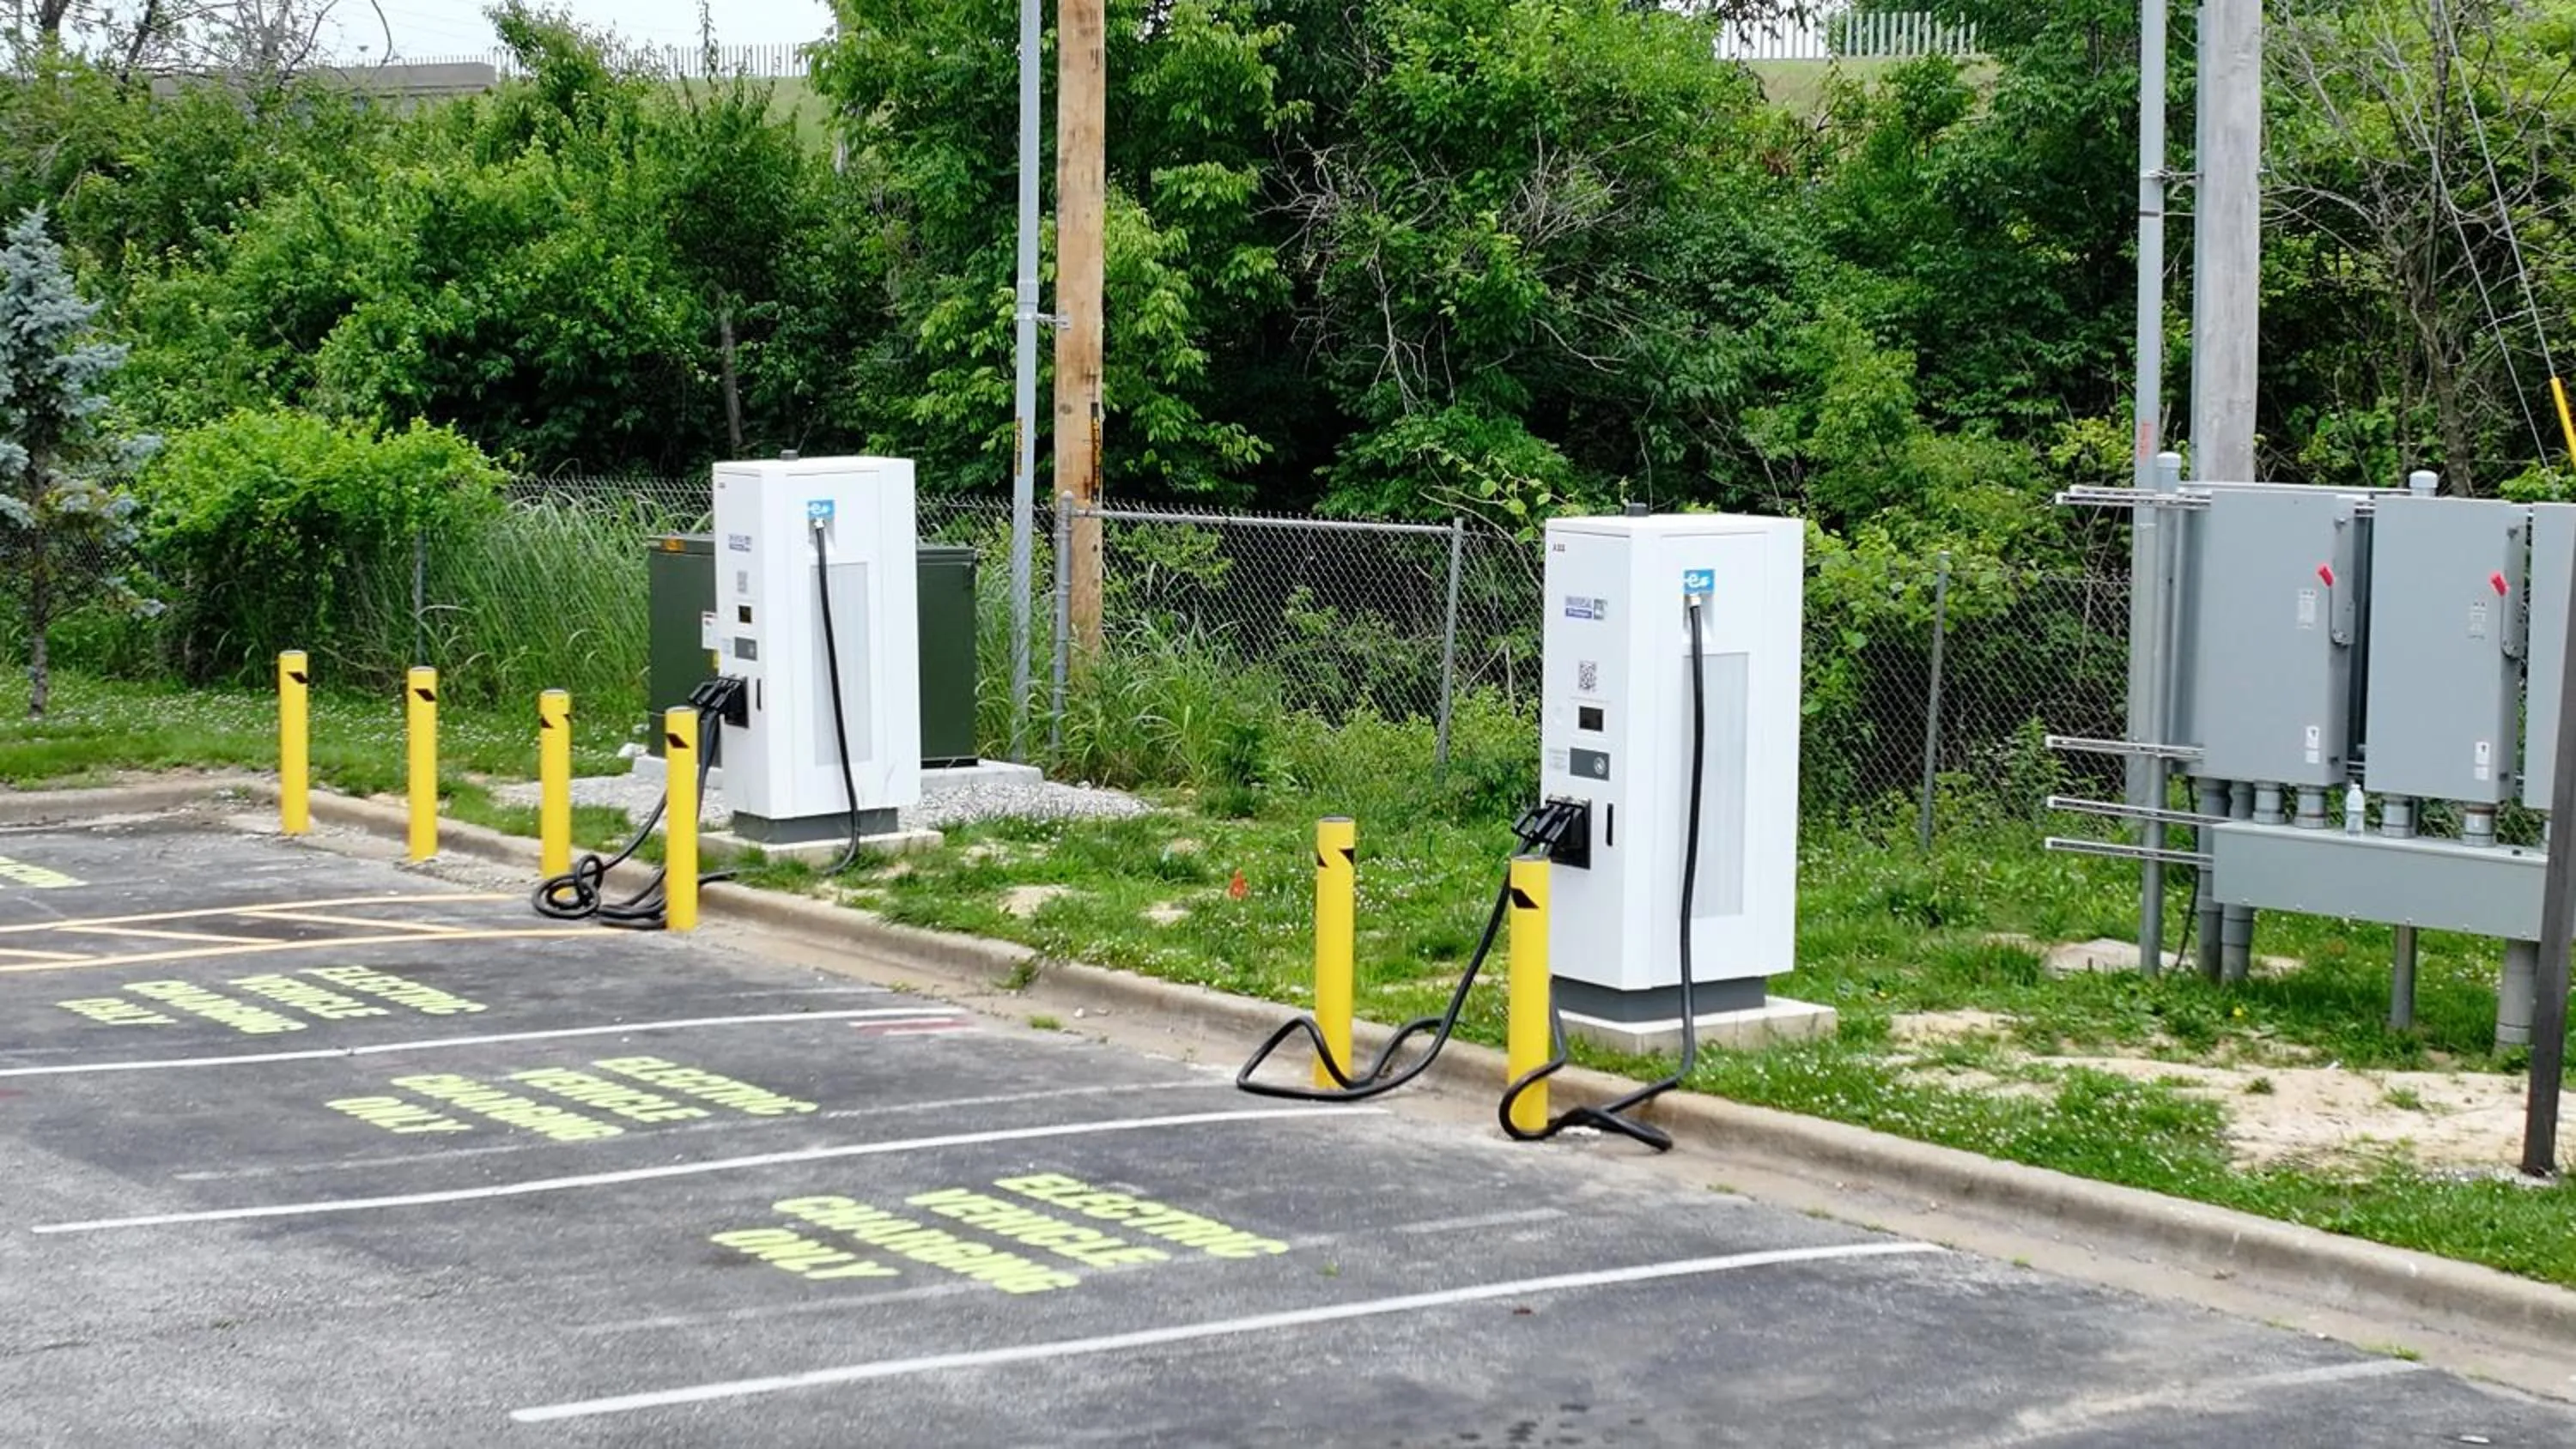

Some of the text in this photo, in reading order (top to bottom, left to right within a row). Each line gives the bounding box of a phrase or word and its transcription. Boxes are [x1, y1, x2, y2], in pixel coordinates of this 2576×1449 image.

[325, 1096, 472, 1133] ONLY
[508, 1067, 711, 1122] VEHICLE
[772, 1196, 1080, 1294] CHARGING
[905, 1188, 1171, 1268] VEHICLE
[993, 1173, 1291, 1259] ELECTRIC
[710, 1228, 900, 1280] ONLY
